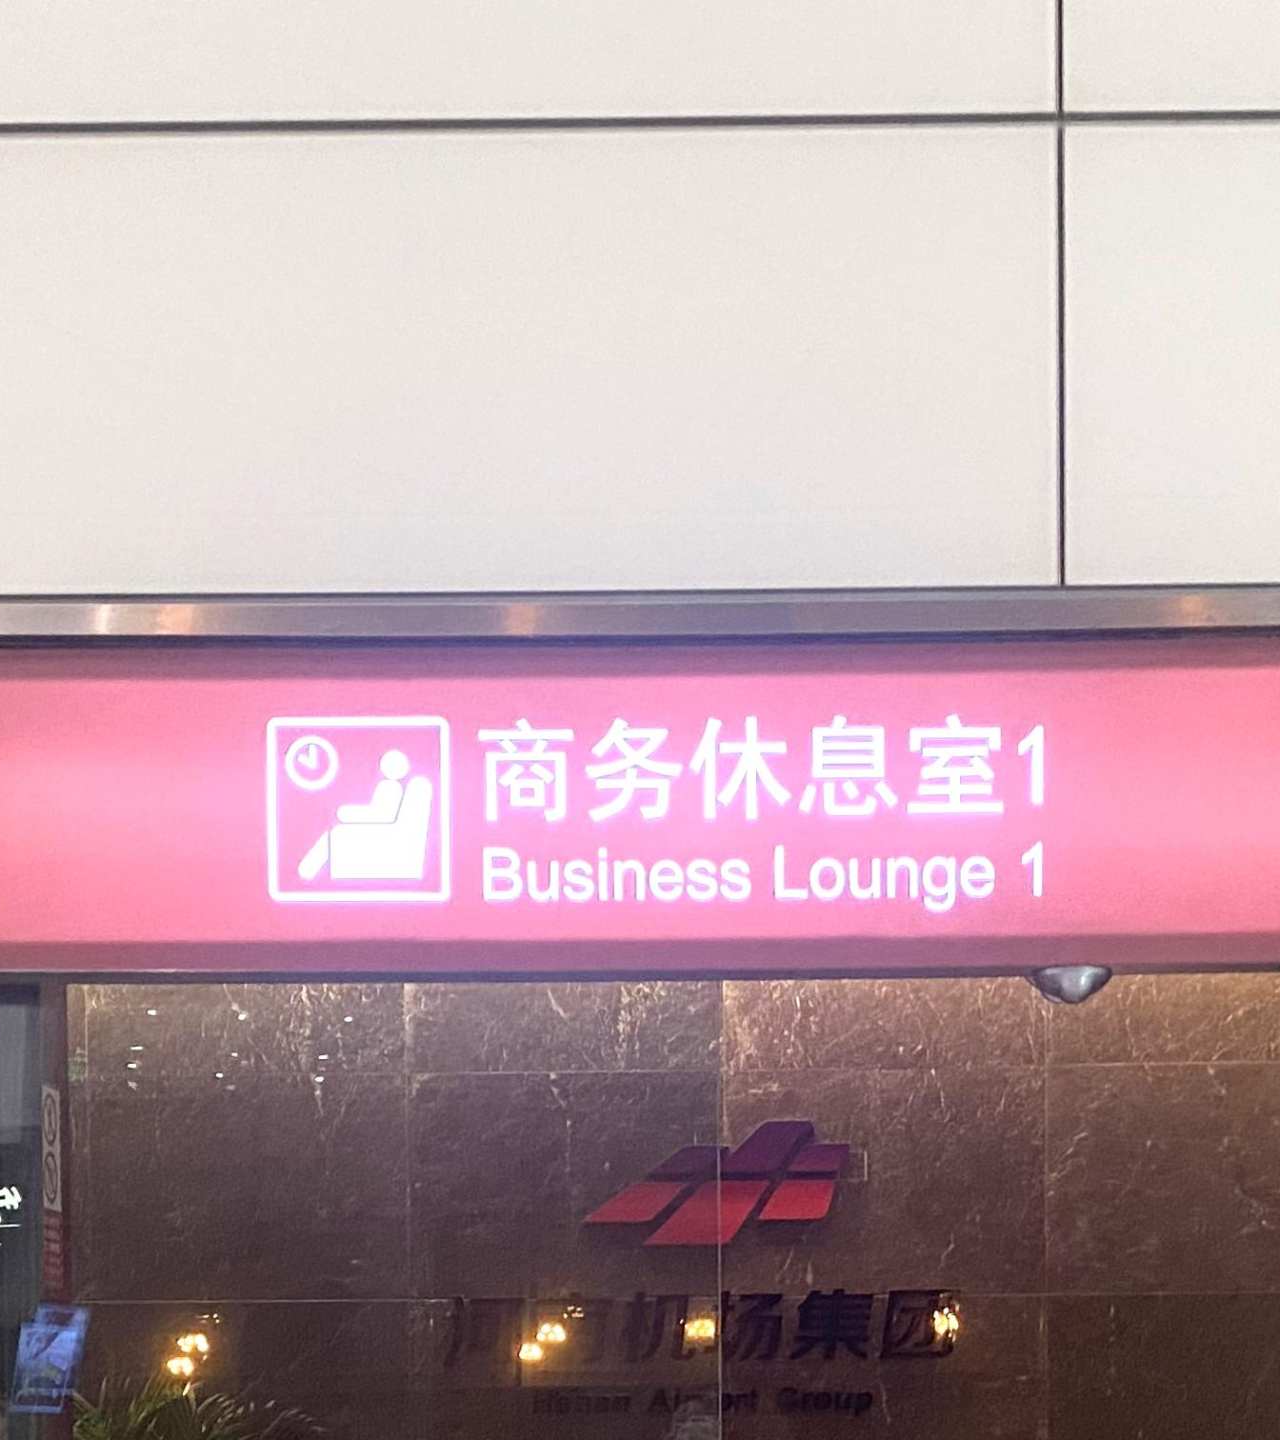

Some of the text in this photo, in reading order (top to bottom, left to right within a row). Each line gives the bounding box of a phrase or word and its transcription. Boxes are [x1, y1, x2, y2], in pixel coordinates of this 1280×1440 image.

[477, 714, 1045, 823] 商务休息室1
[482, 840, 1044, 913] Business Lounge 1
